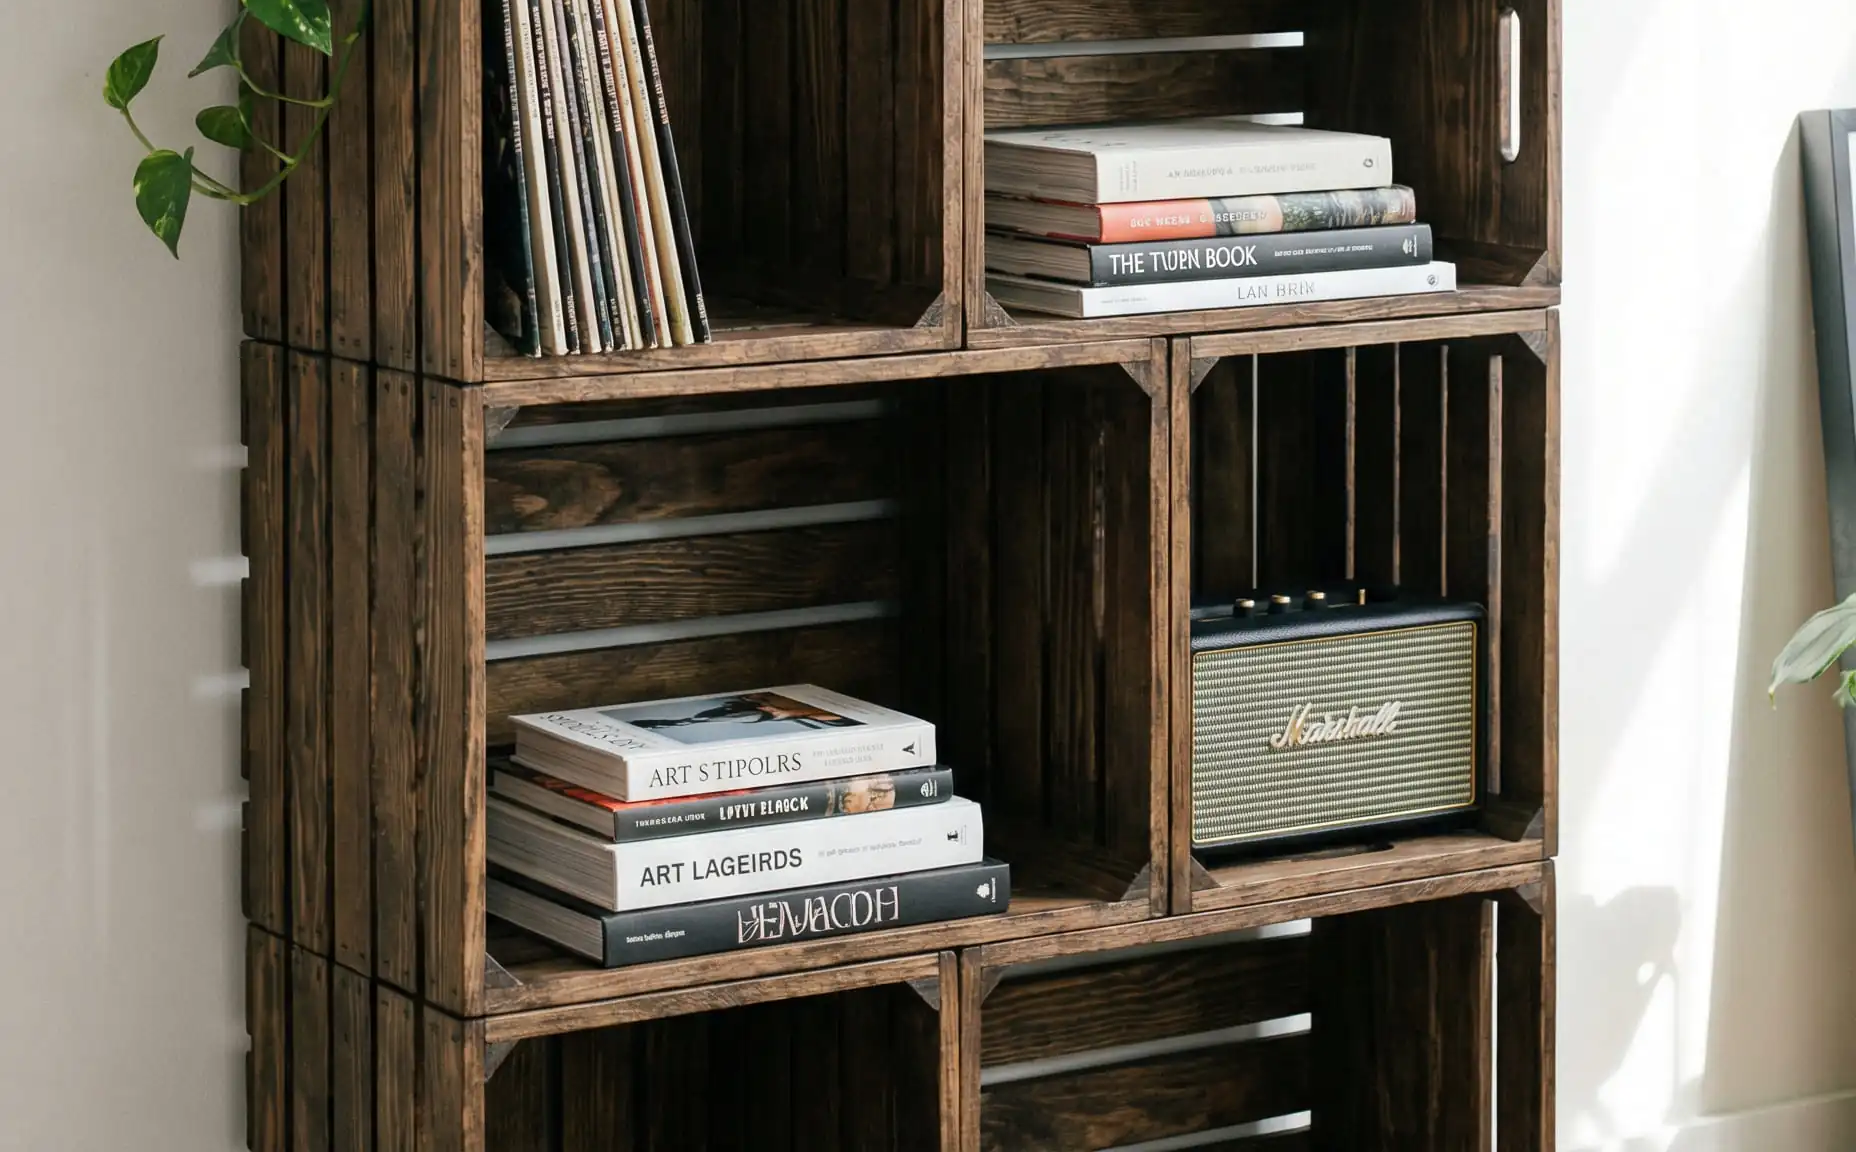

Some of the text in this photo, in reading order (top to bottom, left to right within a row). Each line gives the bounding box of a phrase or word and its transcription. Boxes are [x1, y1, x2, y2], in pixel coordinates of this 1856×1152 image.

[1108, 251, 1145, 276] THE
[1205, 245, 1258, 269] BOOK
[1237, 284, 1268, 300] LAN
[1269, 700, 1402, 750] Marshall
[649, 764, 692, 789] ART
[640, 862, 685, 888] ART
[692, 847, 803, 881] LAGEIRDS
